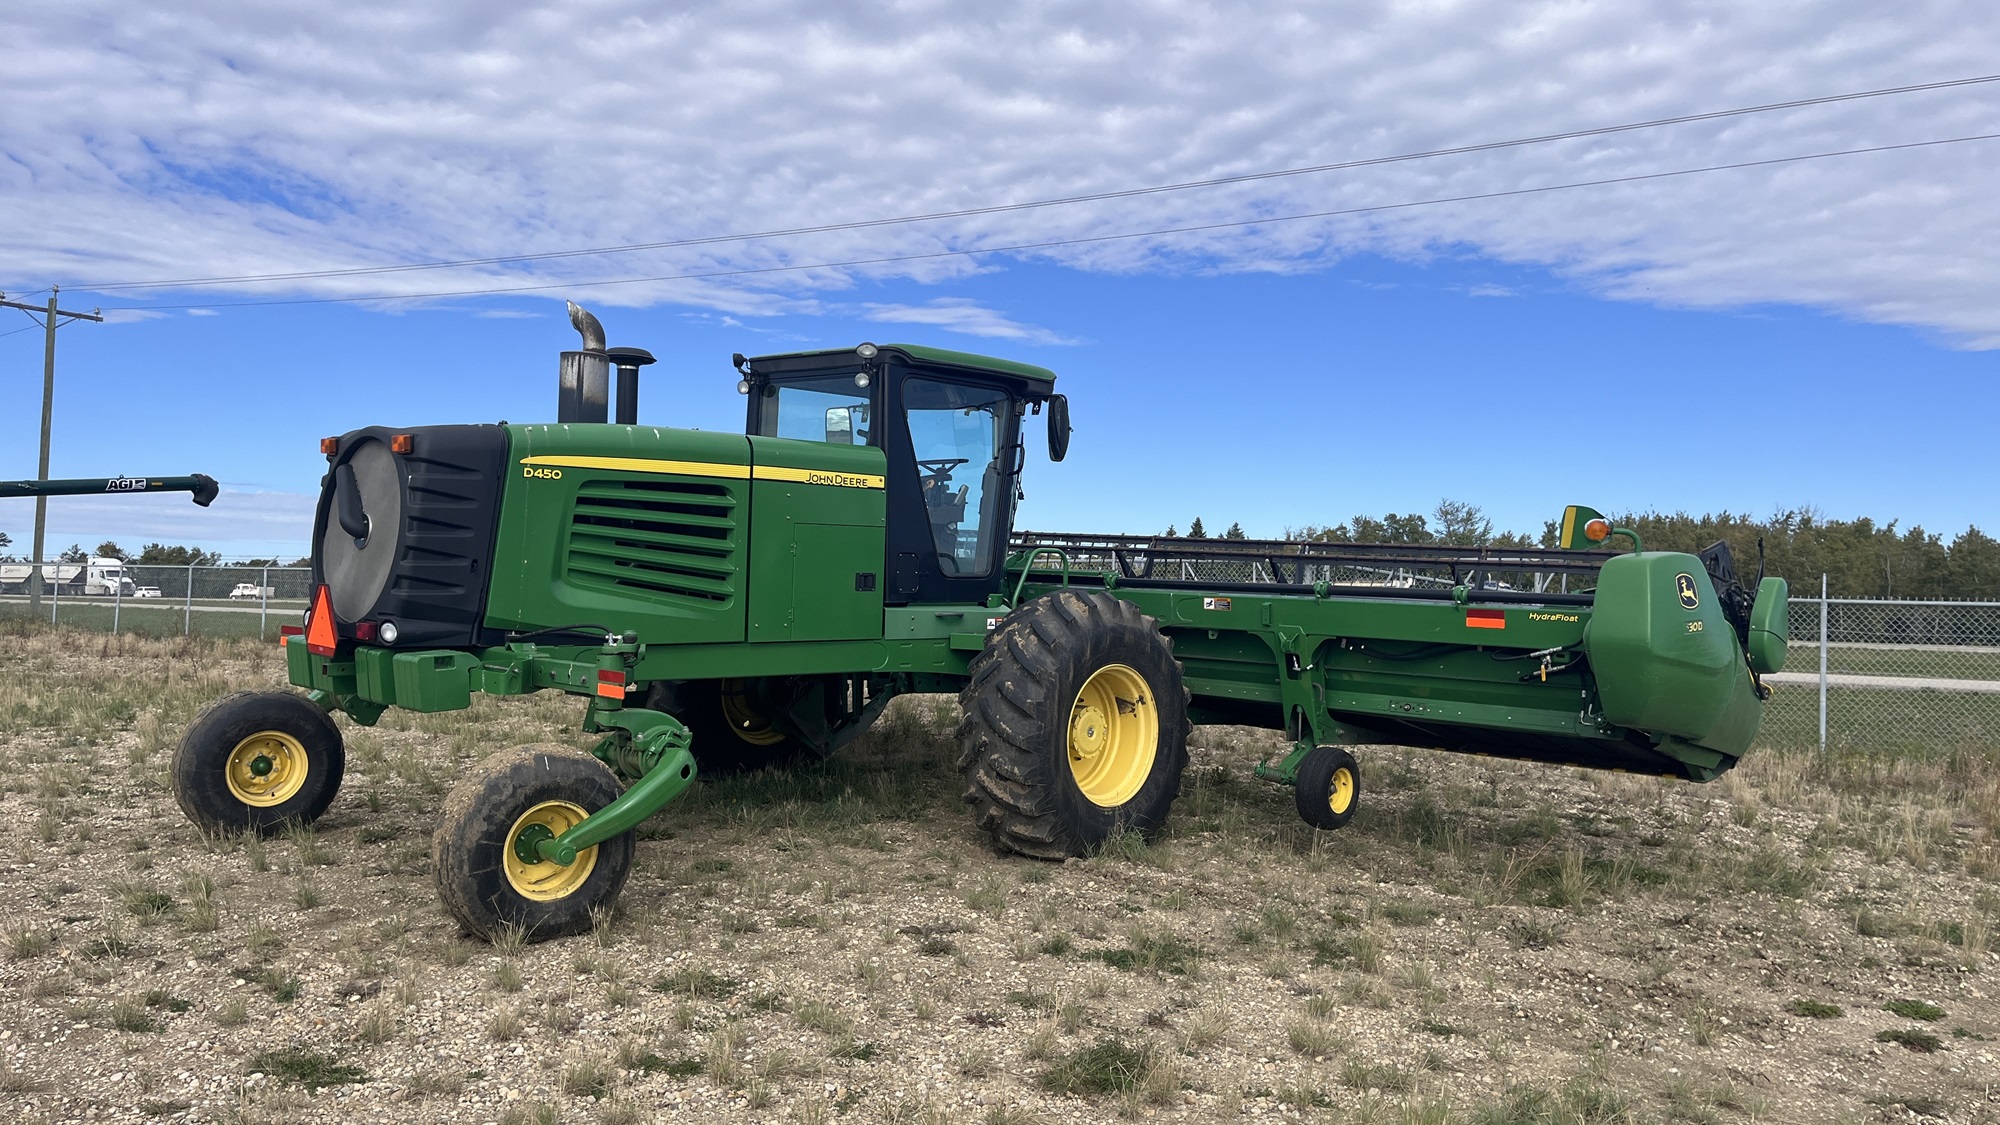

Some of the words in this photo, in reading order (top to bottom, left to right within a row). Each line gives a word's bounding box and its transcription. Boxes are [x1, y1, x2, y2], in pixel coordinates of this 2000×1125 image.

[523, 467, 562, 480] D450
[106, 479, 134, 490] AGI
[1529, 612, 1579, 622] HydraFloat
